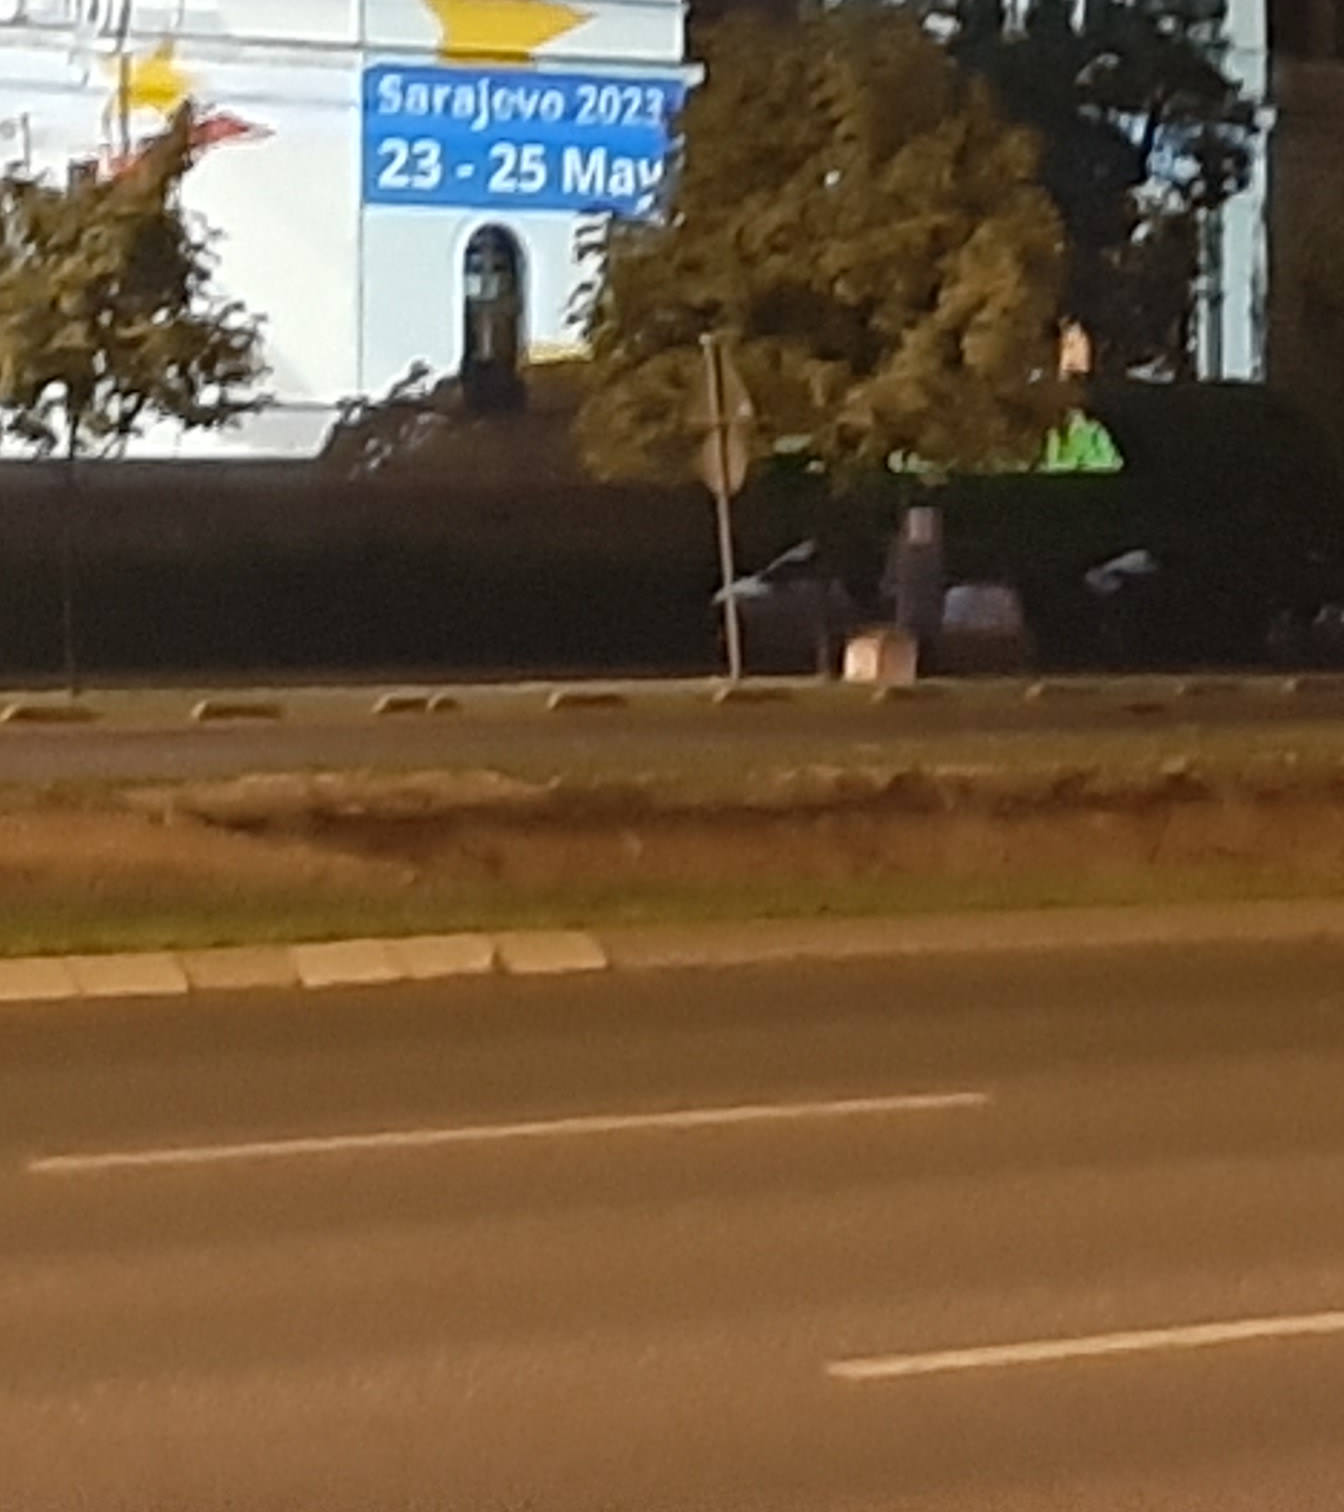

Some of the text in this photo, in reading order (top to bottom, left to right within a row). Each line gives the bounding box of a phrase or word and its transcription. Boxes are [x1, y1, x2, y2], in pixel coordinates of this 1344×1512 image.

[575, 85, 666, 127] 2023
[376, 139, 442, 190] 23
[488, 144, 547, 193] 25
